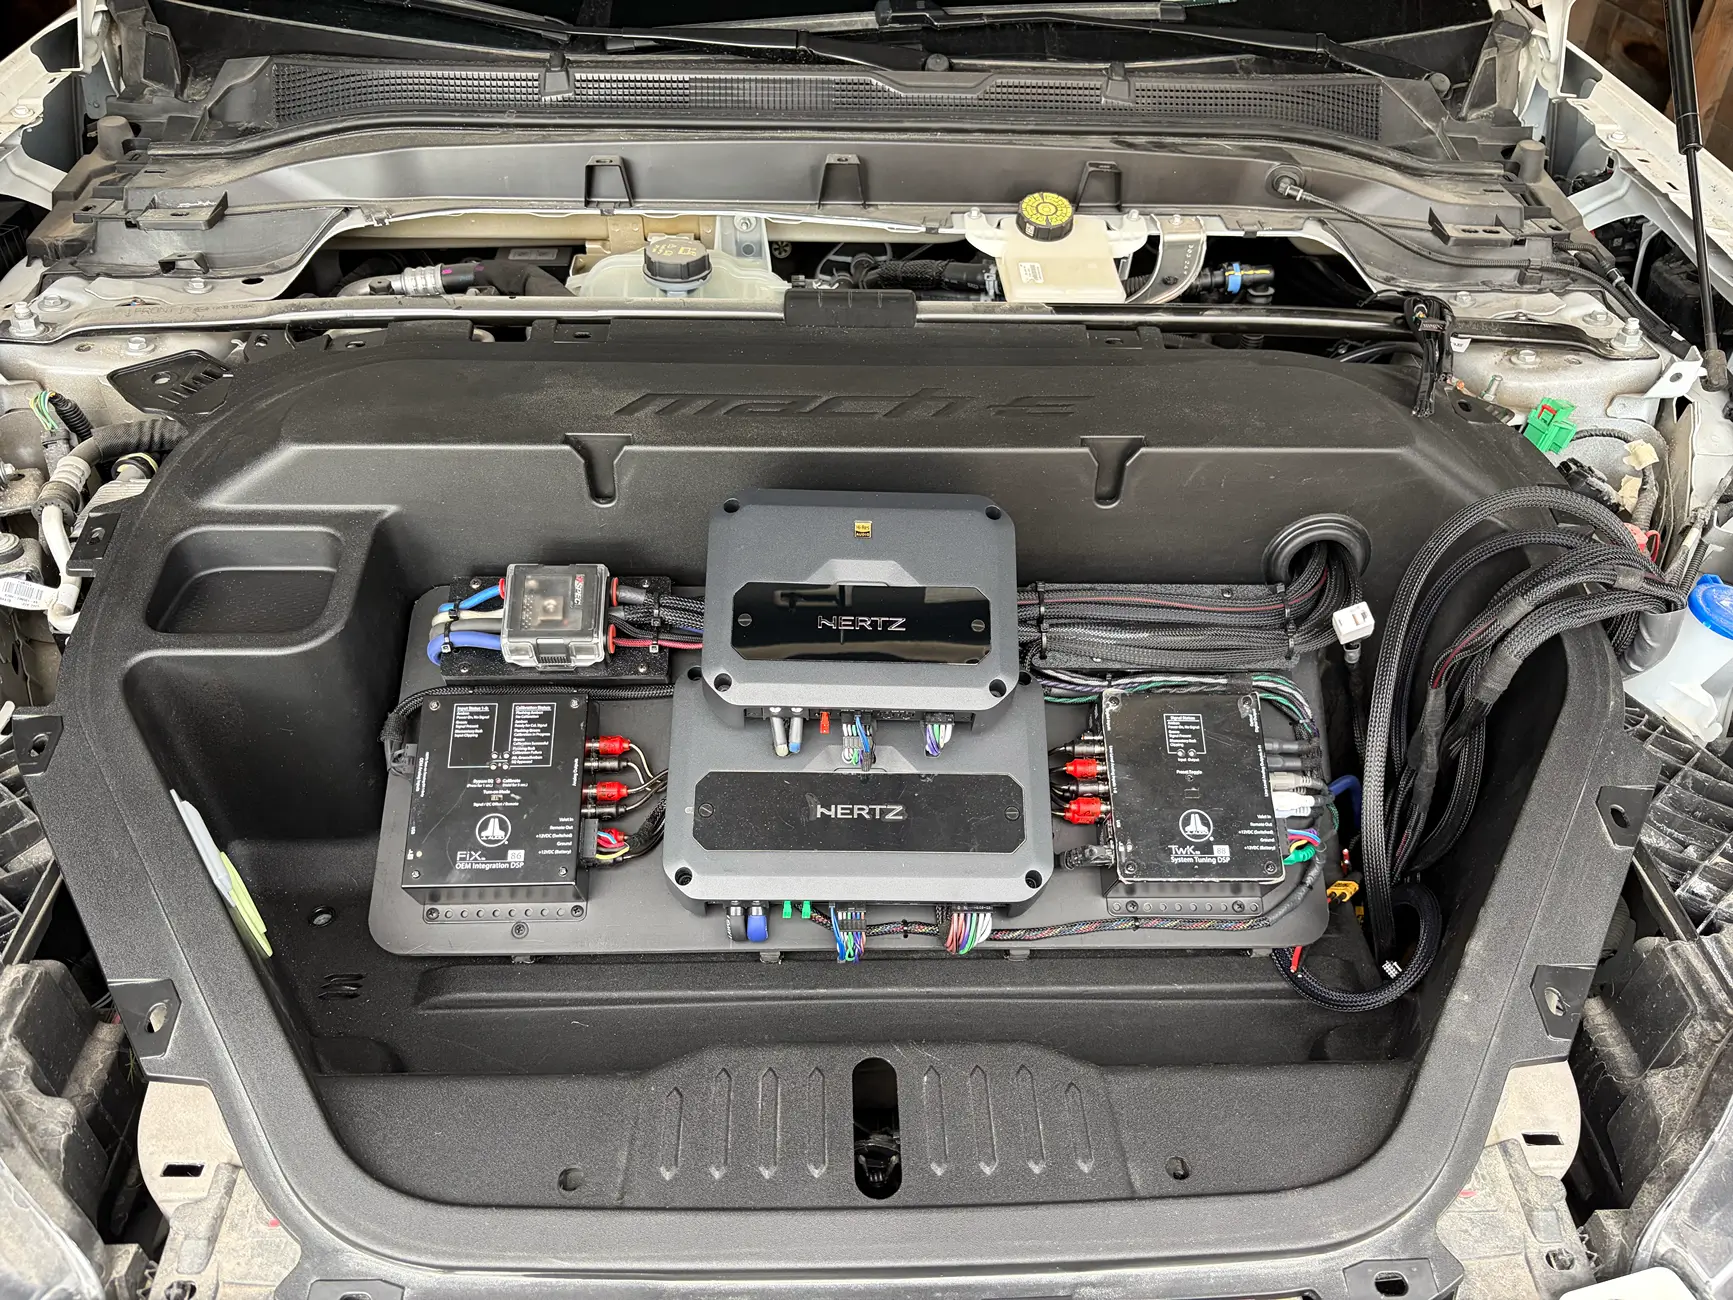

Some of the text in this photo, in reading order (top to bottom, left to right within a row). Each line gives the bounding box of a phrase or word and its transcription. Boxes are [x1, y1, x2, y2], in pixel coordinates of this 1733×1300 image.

[817, 616, 906, 631] HERTZ
[816, 804, 903, 819] HERTZ
[1170, 856, 1193, 864] System
[1194, 856, 1216, 864] Tuning
